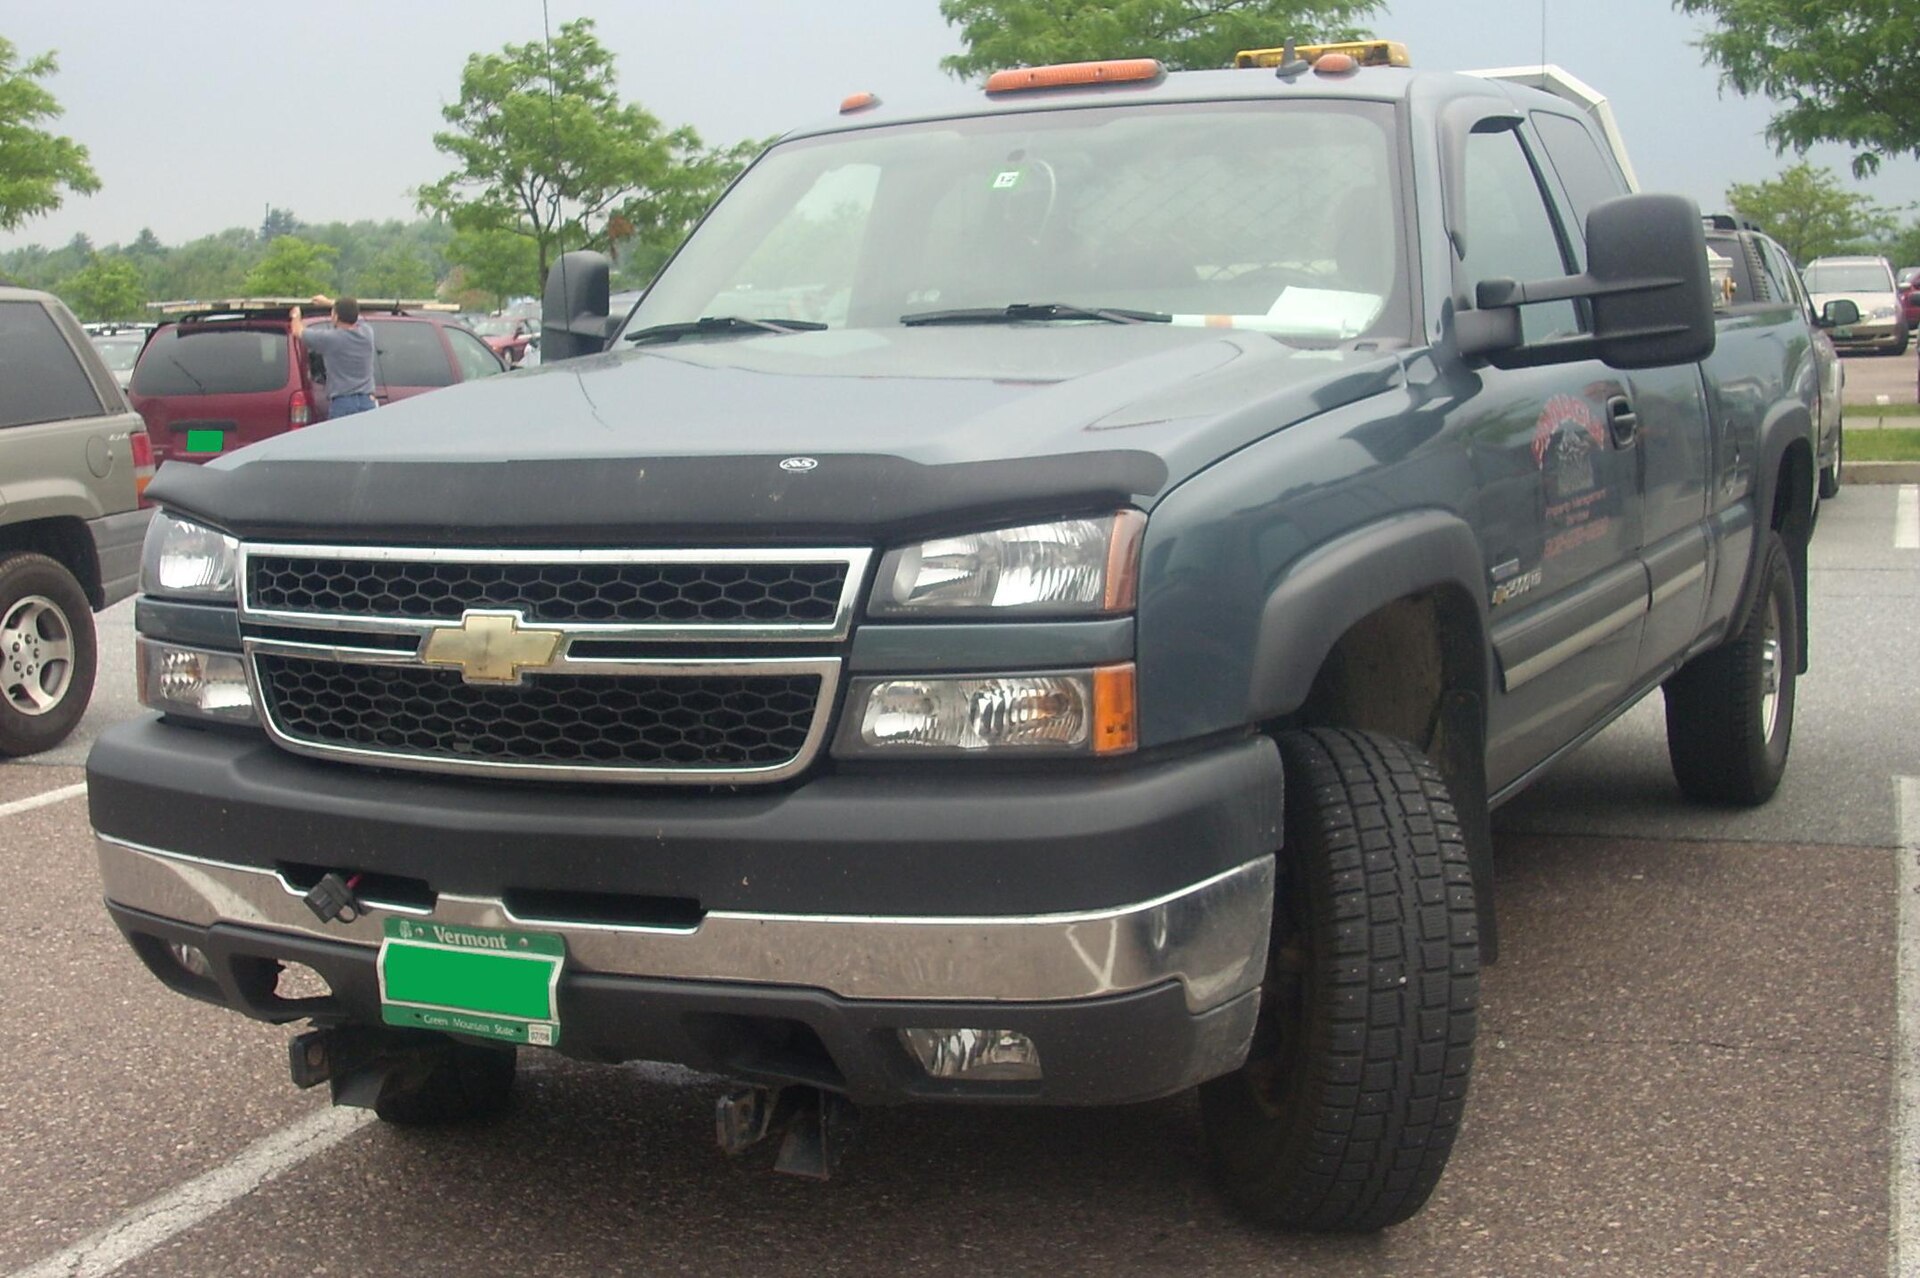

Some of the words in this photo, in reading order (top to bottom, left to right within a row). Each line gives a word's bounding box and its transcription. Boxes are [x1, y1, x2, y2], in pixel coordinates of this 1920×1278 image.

[433, 925, 508, 949] Vermont
[423, 1014, 448, 1026] Green
[453, 1018, 490, 1032] Mountain
[495, 1023, 514, 1036] State
